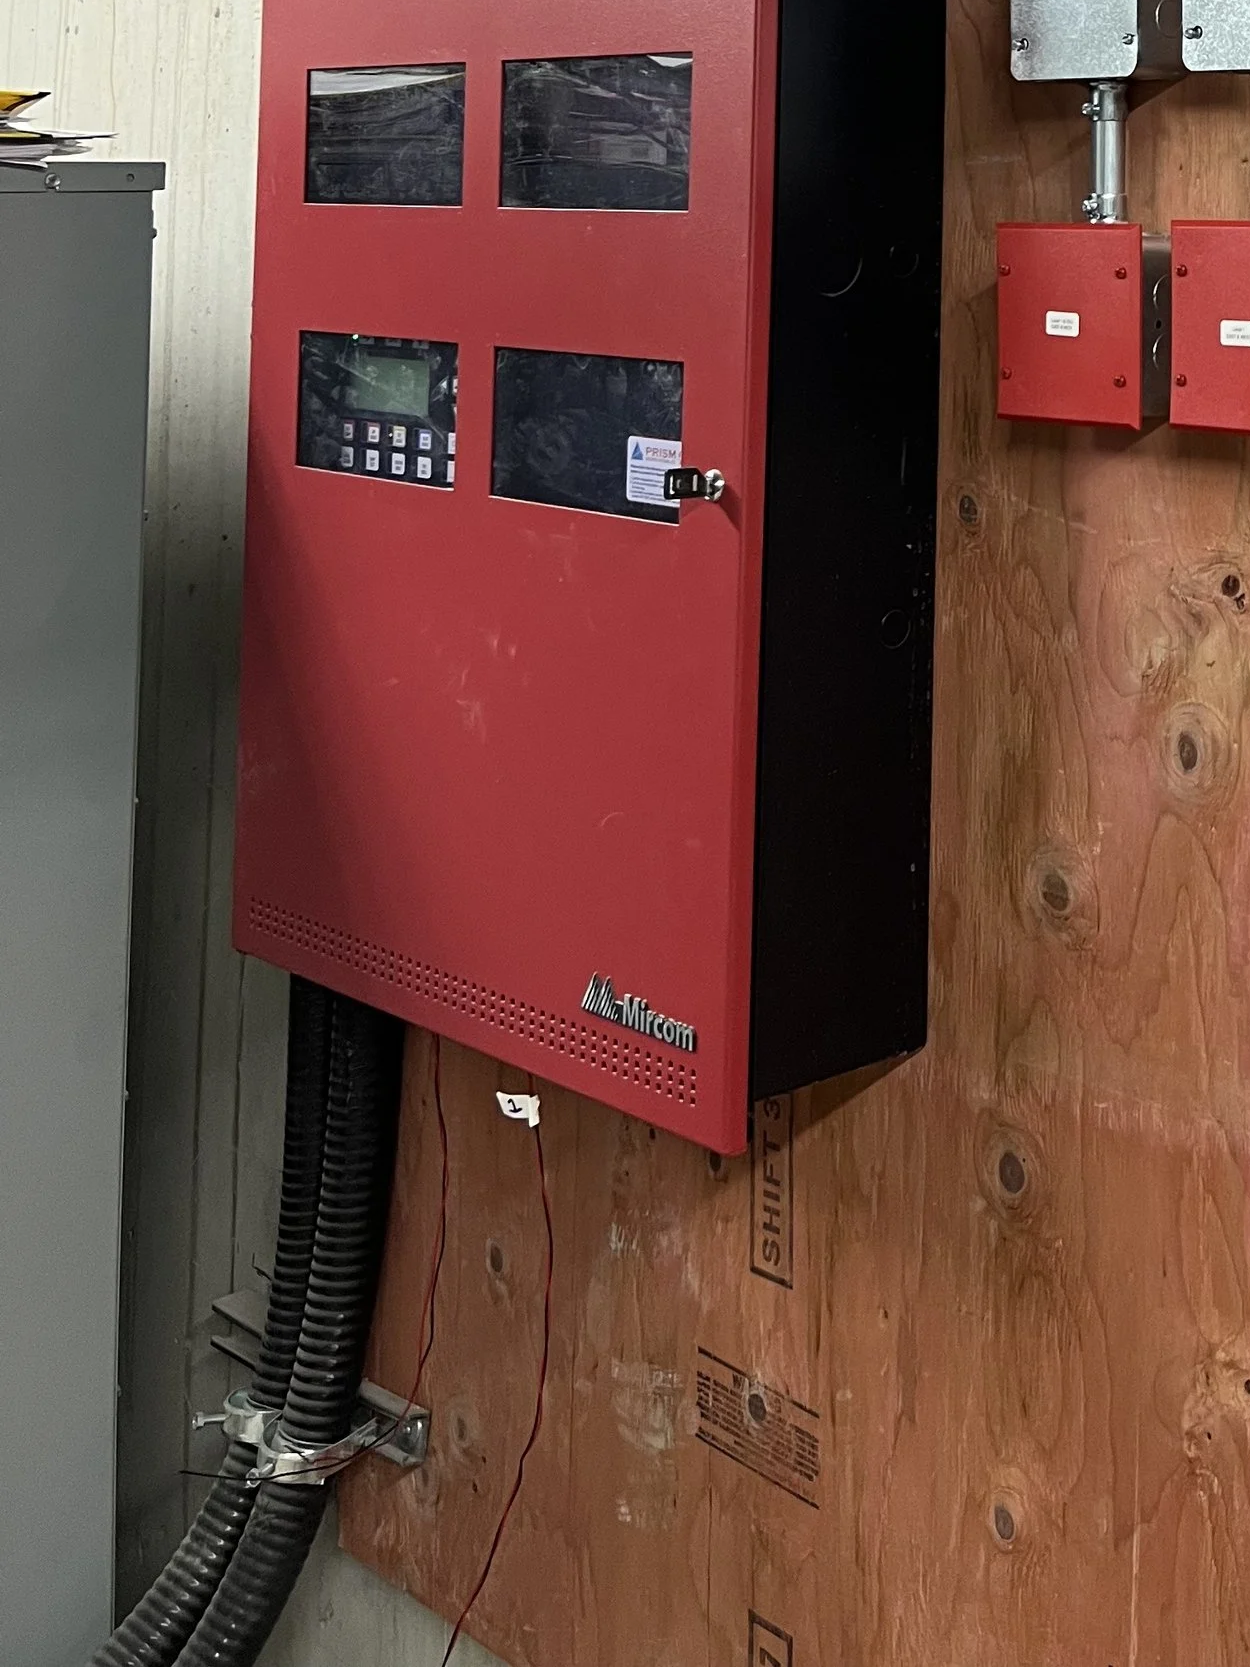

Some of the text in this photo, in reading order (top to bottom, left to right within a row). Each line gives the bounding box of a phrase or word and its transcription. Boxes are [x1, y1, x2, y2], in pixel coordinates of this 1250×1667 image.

[645, 446, 678, 461] PRISM
[622, 992, 698, 1054] Mircom
[506, 1097, 524, 1114] 1
[761, 1129, 782, 1267] SHIFT
